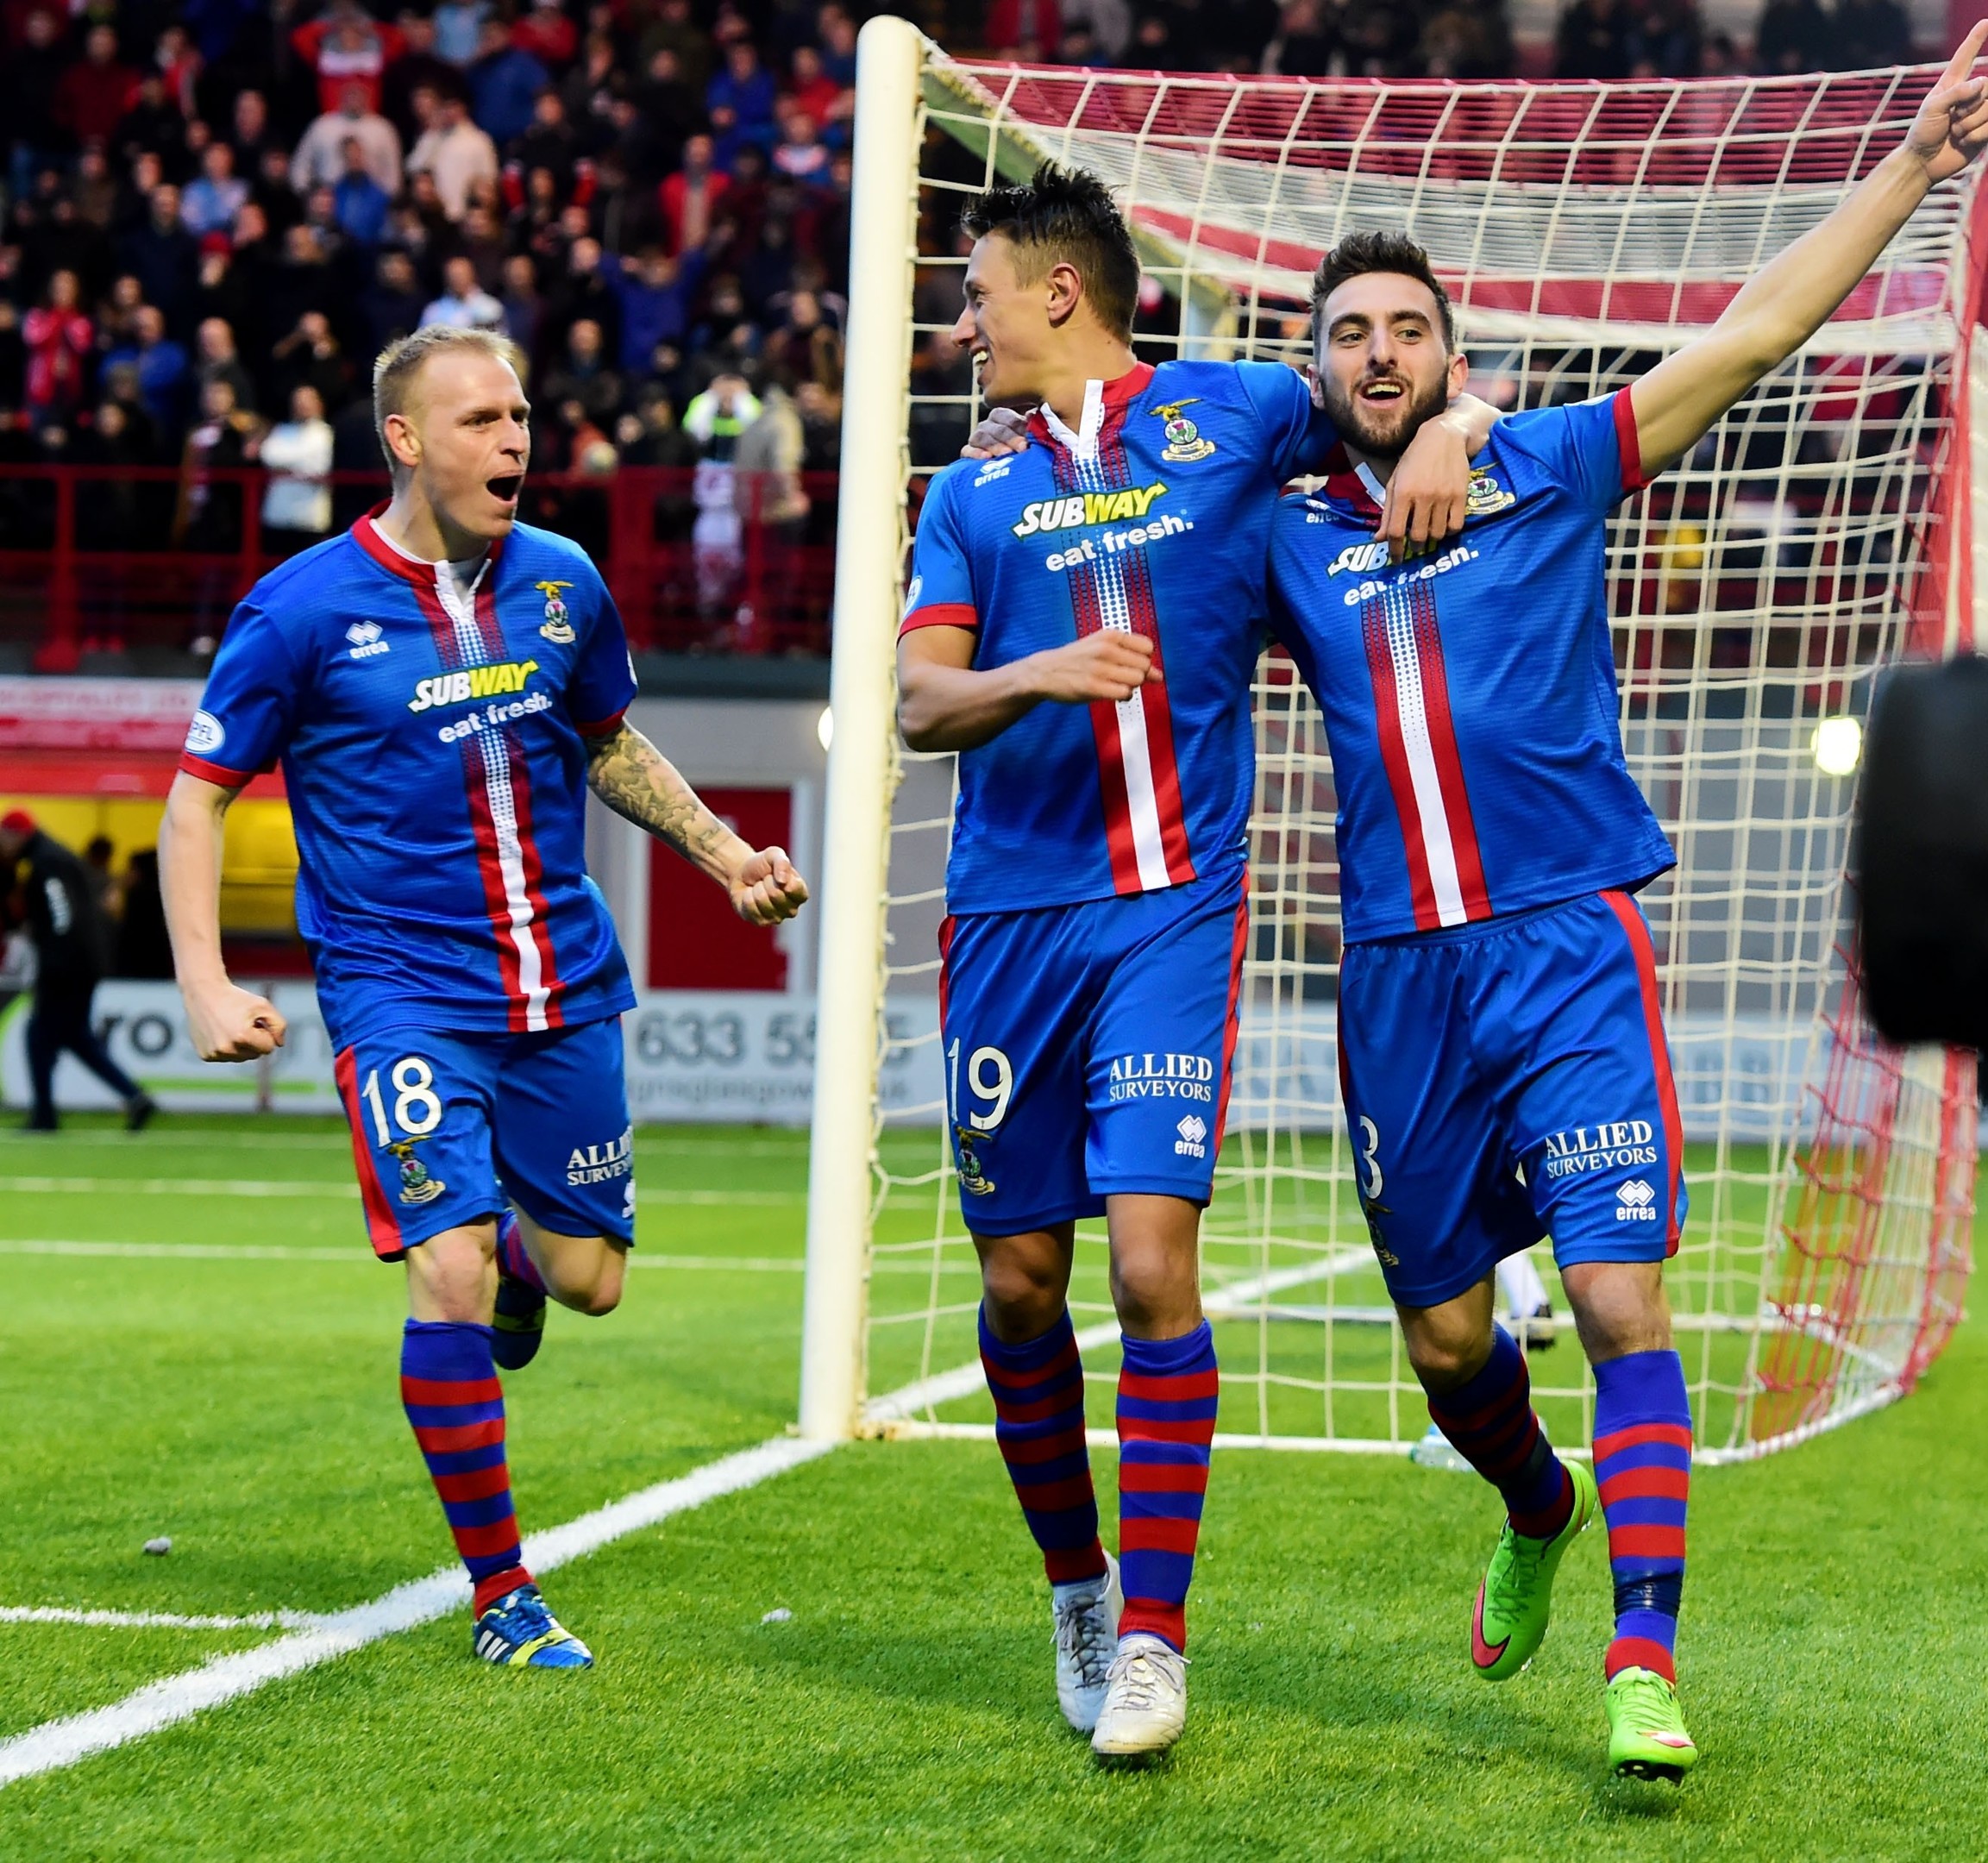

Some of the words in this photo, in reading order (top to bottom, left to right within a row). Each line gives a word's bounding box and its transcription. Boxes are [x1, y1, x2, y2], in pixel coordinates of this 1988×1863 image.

[974, 467, 1010, 487] errea
[1012, 481, 1168, 538] SUBWAY
[1045, 539, 1096, 572] eat
[1102, 515, 1194, 554] fresh.
[1344, 580, 1387, 606] eat
[350, 641, 389, 659] errea
[409, 660, 539, 713] SUBWAY
[438, 713, 483, 743] eat
[486, 692, 553, 725] fresh.
[637, 1010, 744, 1068] 633
[947, 1037, 1013, 1130] 19
[1109, 1053, 1213, 1084] ALLIED
[361, 1057, 442, 1148] 18
[1109, 1080, 1212, 1103] SURVEYORS
[1175, 1140, 1205, 1158] errea
[1359, 1114, 1383, 1200] 3
[1546, 1120, 1652, 1159] ALLIED
[1546, 1145, 1658, 1179] SURVEYORS
[1616, 1205, 1656, 1221] errea
